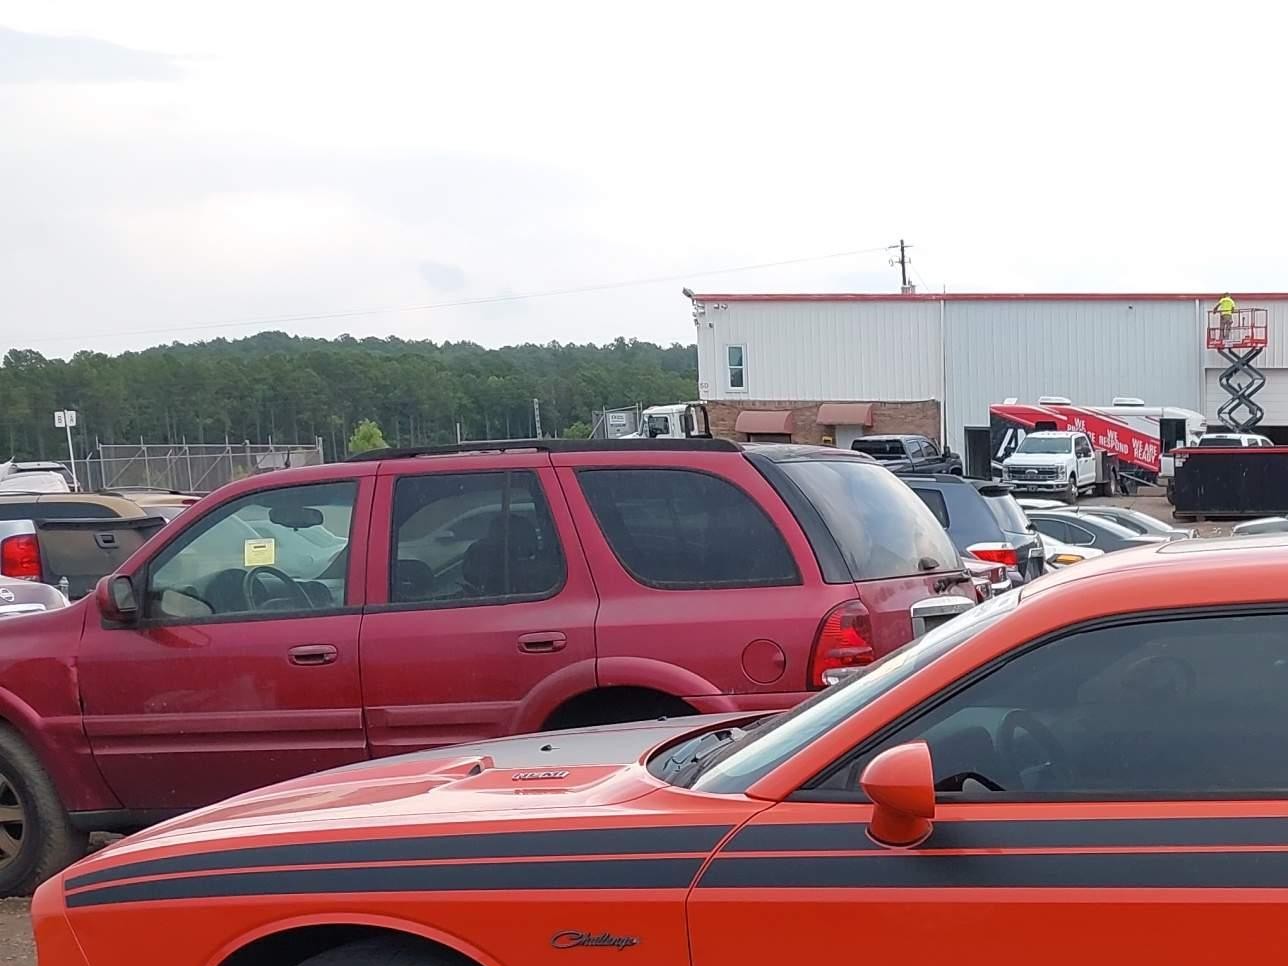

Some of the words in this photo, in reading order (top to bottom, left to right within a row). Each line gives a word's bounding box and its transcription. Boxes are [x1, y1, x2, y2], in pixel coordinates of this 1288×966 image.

[1074, 417, 1086, 430] WE
[1107, 429, 1118, 441] WE
[1098, 435, 1129, 455] RESPOND
[1131, 438, 1143, 451] WE
[1144, 442, 1158, 456] ARE
[1134, 448, 1156, 464] READY
